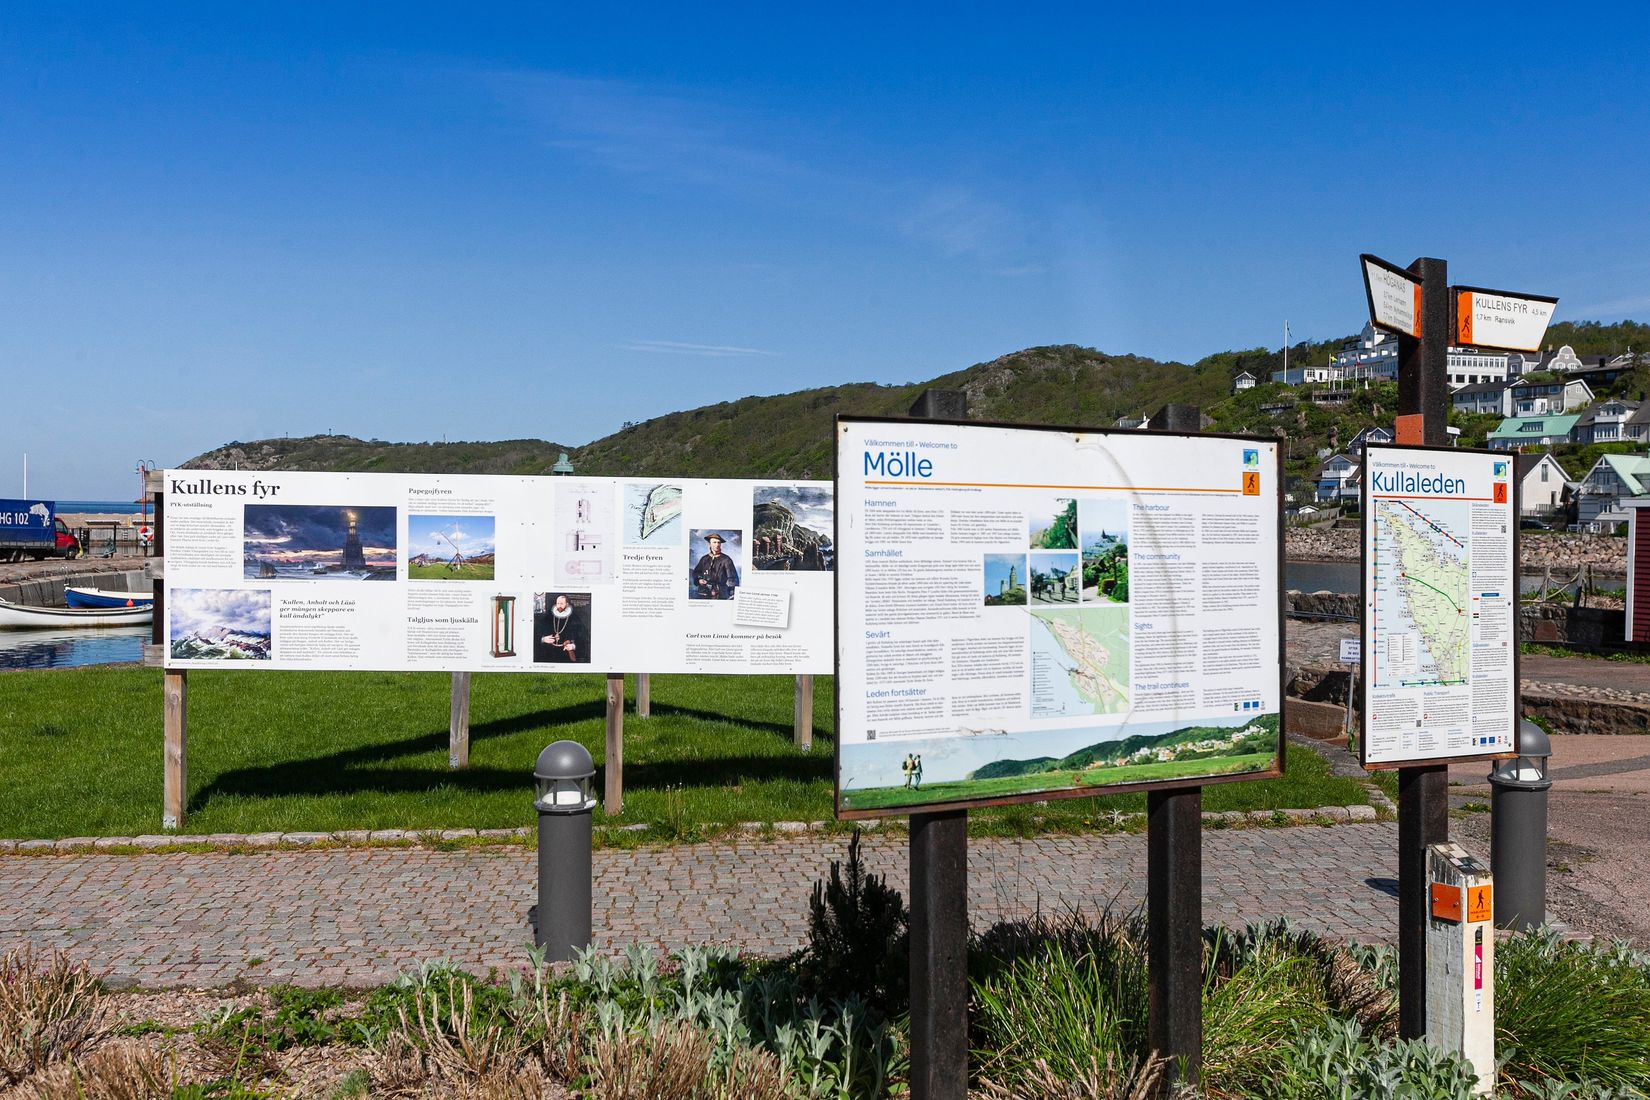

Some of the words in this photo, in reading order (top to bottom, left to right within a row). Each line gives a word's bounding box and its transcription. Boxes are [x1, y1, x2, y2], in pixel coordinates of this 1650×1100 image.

[1476, 298, 1512, 312] KULLENS
[1514, 303, 1528, 314] FYR
[1495, 316, 1515, 325] Ransvik
[864, 439, 905, 448] Välkommen
[906, 440, 914, 448] till
[919, 441, 950, 449] Welcome
[864, 451, 933, 477] Mölle
[1372, 471, 1465, 494] Kullaleden
[171, 479, 247, 495] Kullens
[252, 480, 280, 499] fyr
[15, 512, 29, 525] 102
[1134, 622, 1153, 631] Sights
[1147, 682, 1159, 690] trail
[1160, 681, 1189, 689] continues
[866, 690, 890, 698] Leden
[891, 688, 926, 696] fortsätter
